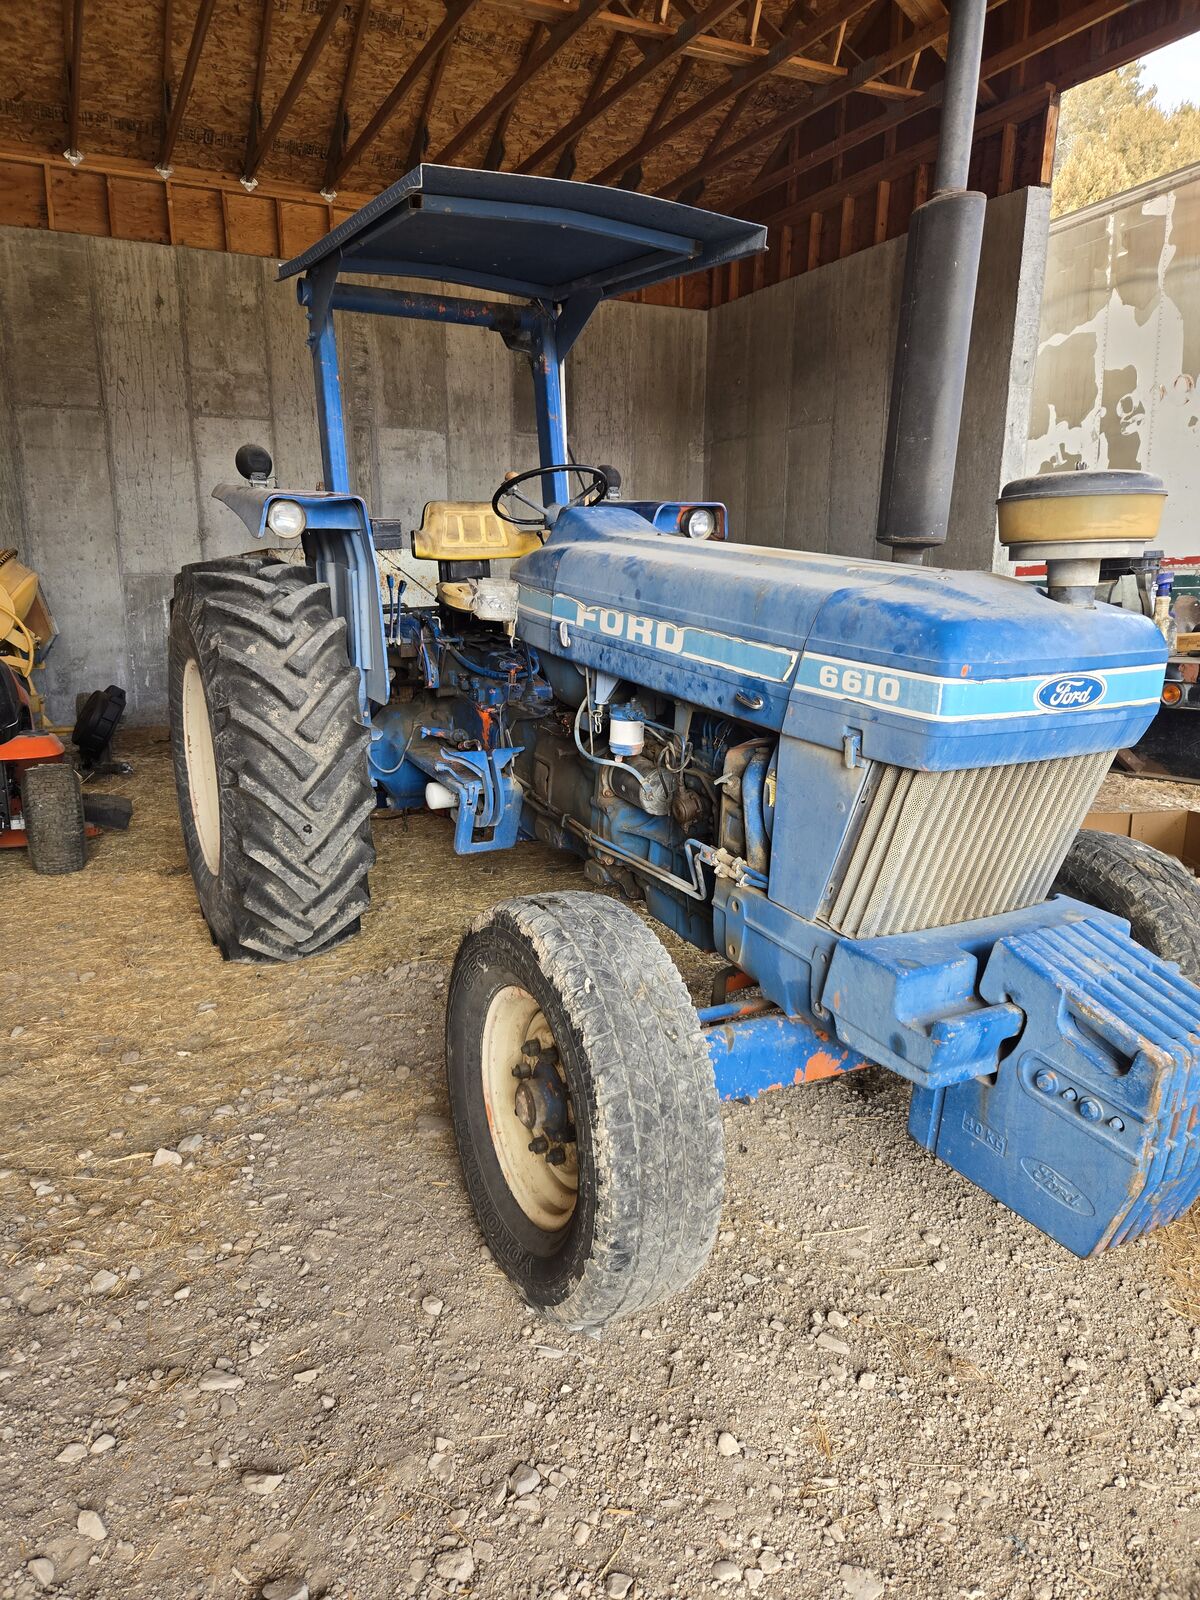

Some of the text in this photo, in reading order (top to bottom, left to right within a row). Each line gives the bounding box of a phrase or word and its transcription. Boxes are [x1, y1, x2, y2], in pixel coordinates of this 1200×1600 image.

[576, 606, 685, 654] FORD
[819, 664, 901, 702] 6610
[1050, 679, 1094, 706] Ford
[964, 1117, 983, 1135] 40
[1033, 1165, 1081, 1206] Ford
